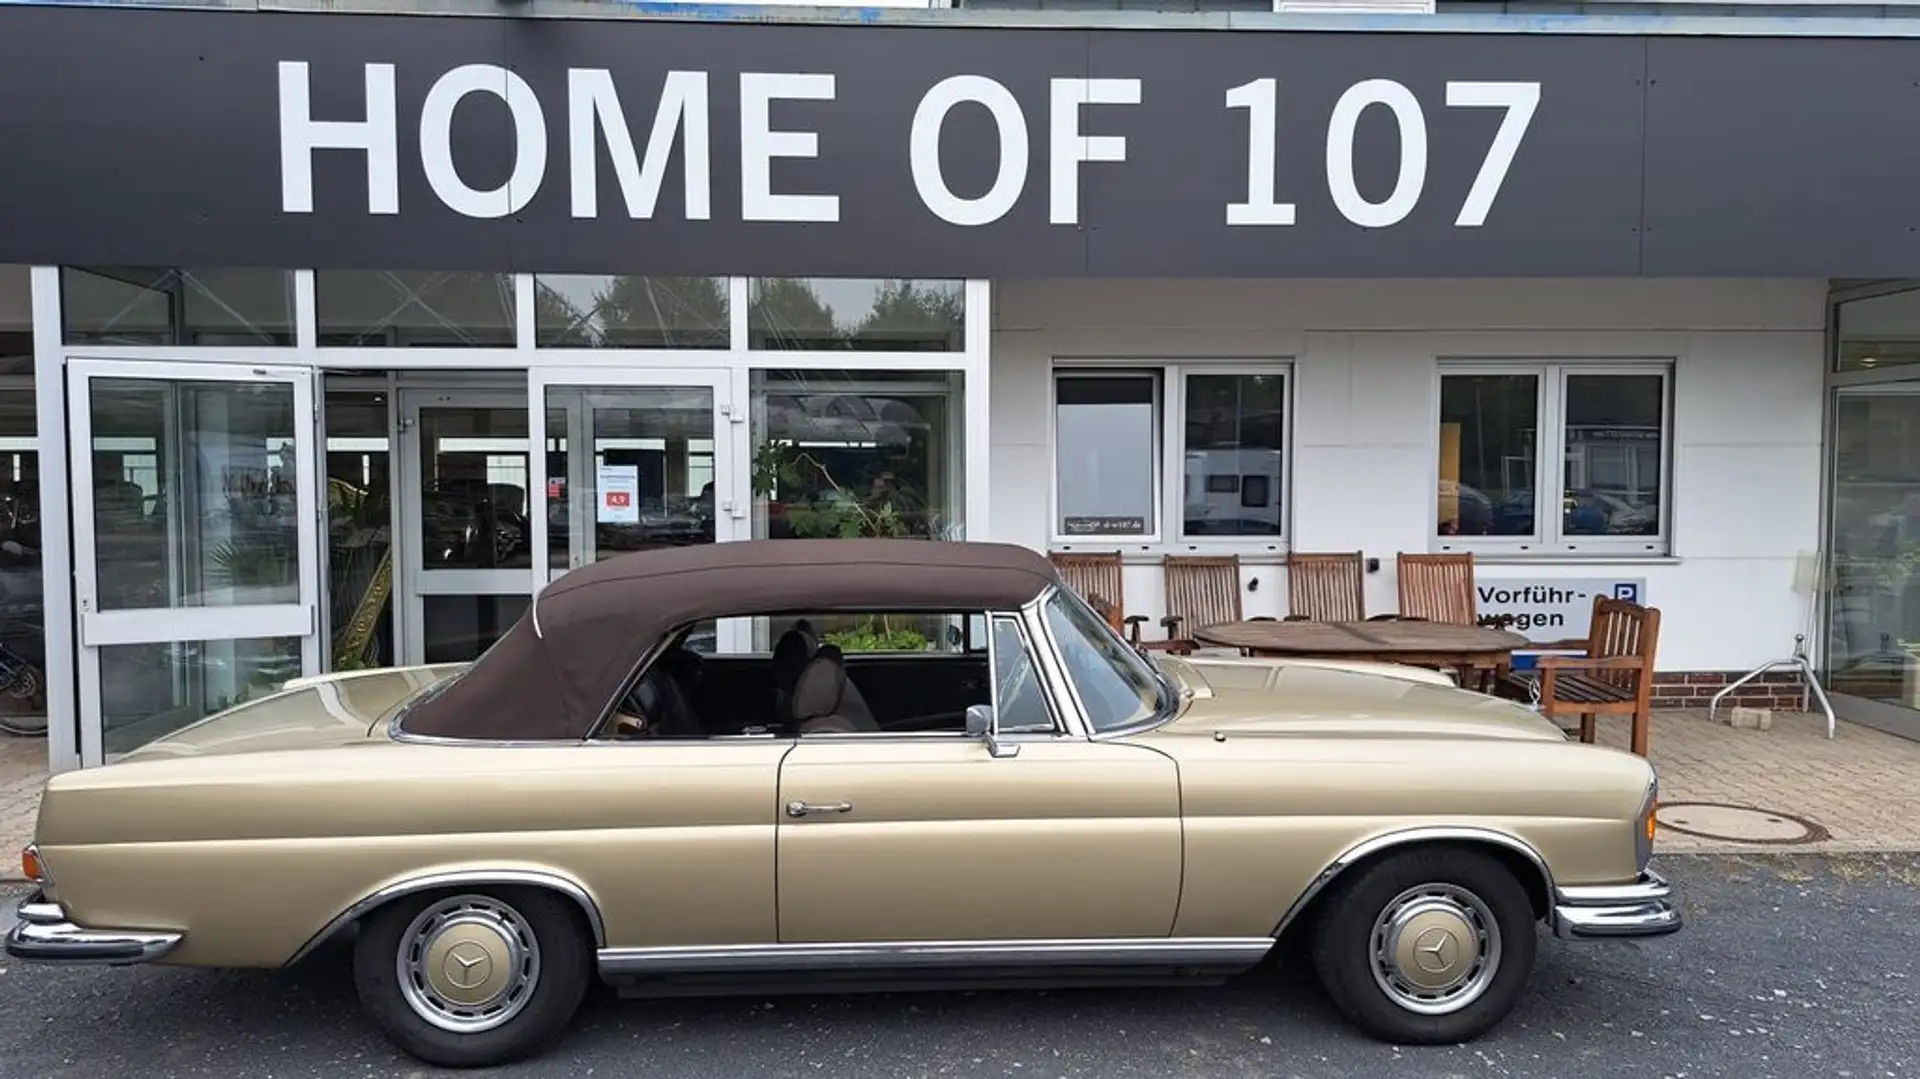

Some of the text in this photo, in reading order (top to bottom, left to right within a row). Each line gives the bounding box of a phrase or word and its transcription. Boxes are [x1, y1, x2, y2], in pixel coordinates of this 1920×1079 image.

[279, 61, 1541, 228] HOME OF 107
[1478, 586, 1586, 604] Vorführ-
[1617, 587, 1634, 601] P
